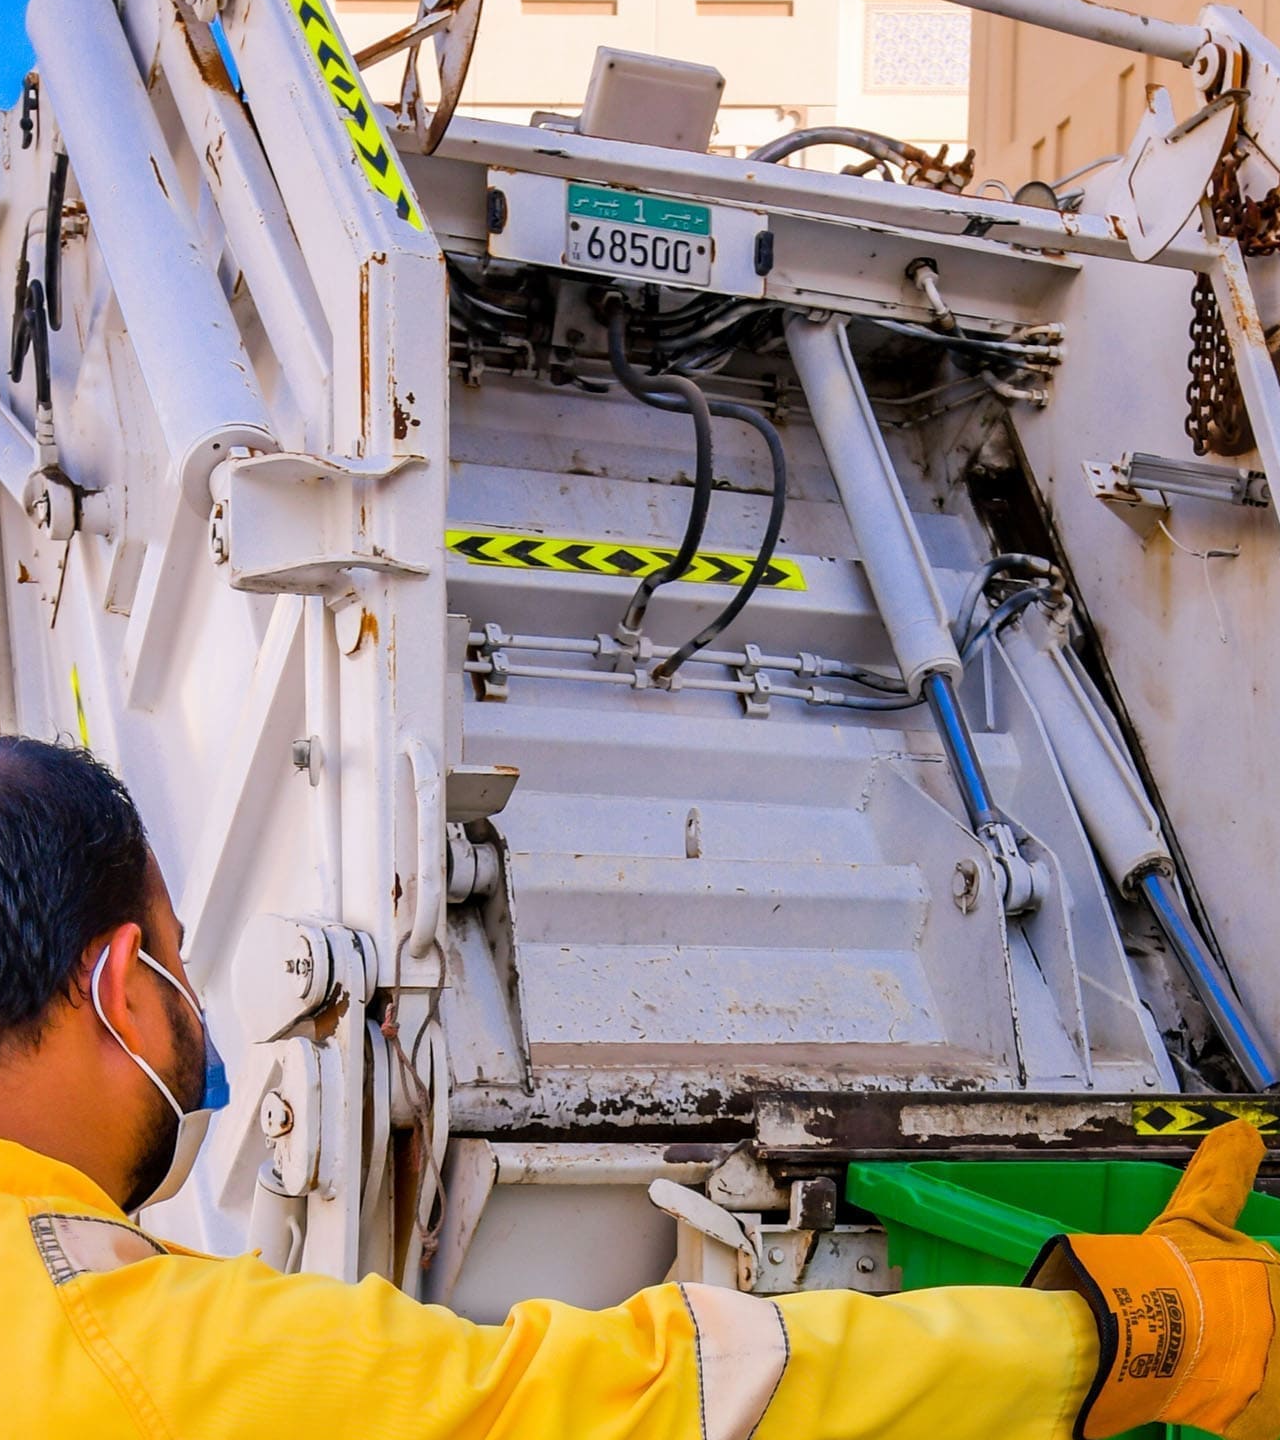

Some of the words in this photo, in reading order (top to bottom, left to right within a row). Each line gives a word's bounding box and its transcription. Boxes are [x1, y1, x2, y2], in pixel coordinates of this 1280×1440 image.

[634, 199, 646, 223] 1
[587, 225, 691, 274] 68500
[1160, 1292, 1182, 1375] BORDER
